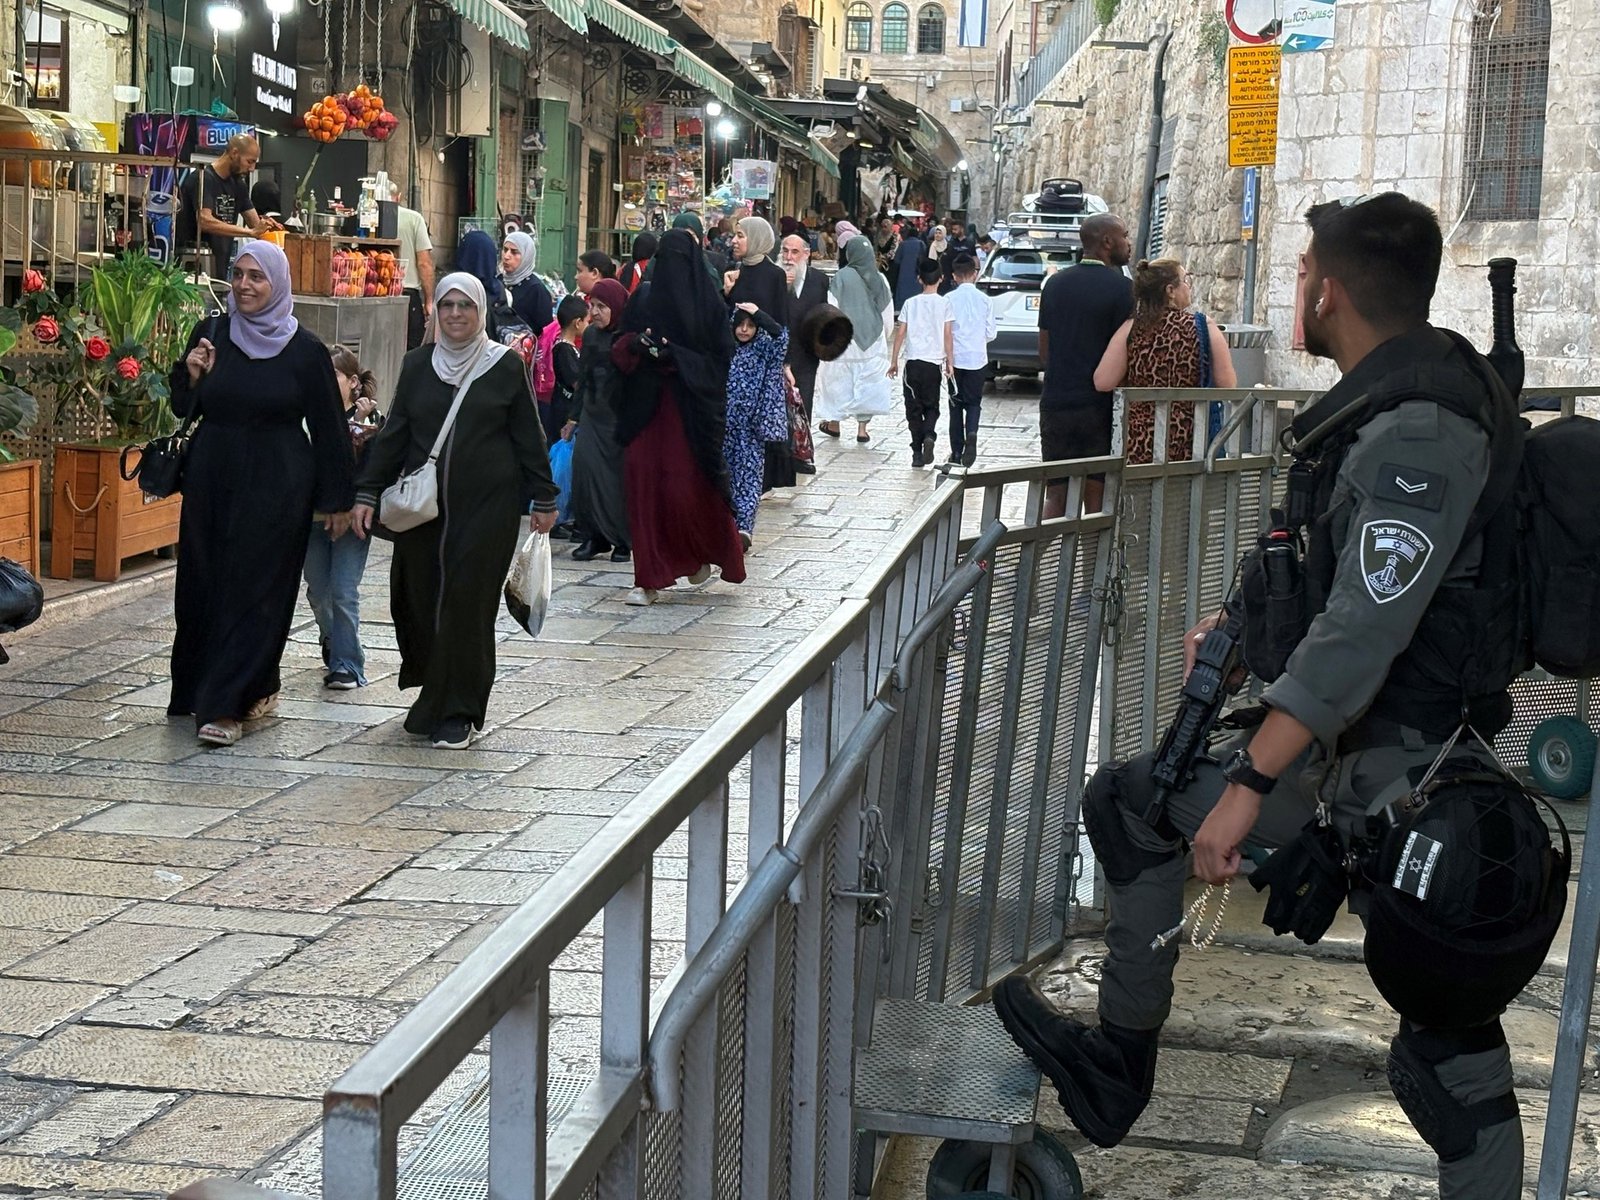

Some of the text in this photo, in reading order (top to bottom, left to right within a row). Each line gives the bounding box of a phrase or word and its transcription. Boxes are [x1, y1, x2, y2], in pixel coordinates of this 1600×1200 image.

[1236, 59, 1260, 67] מורשה
[1371, 526, 1426, 552] משטרת ישראל
